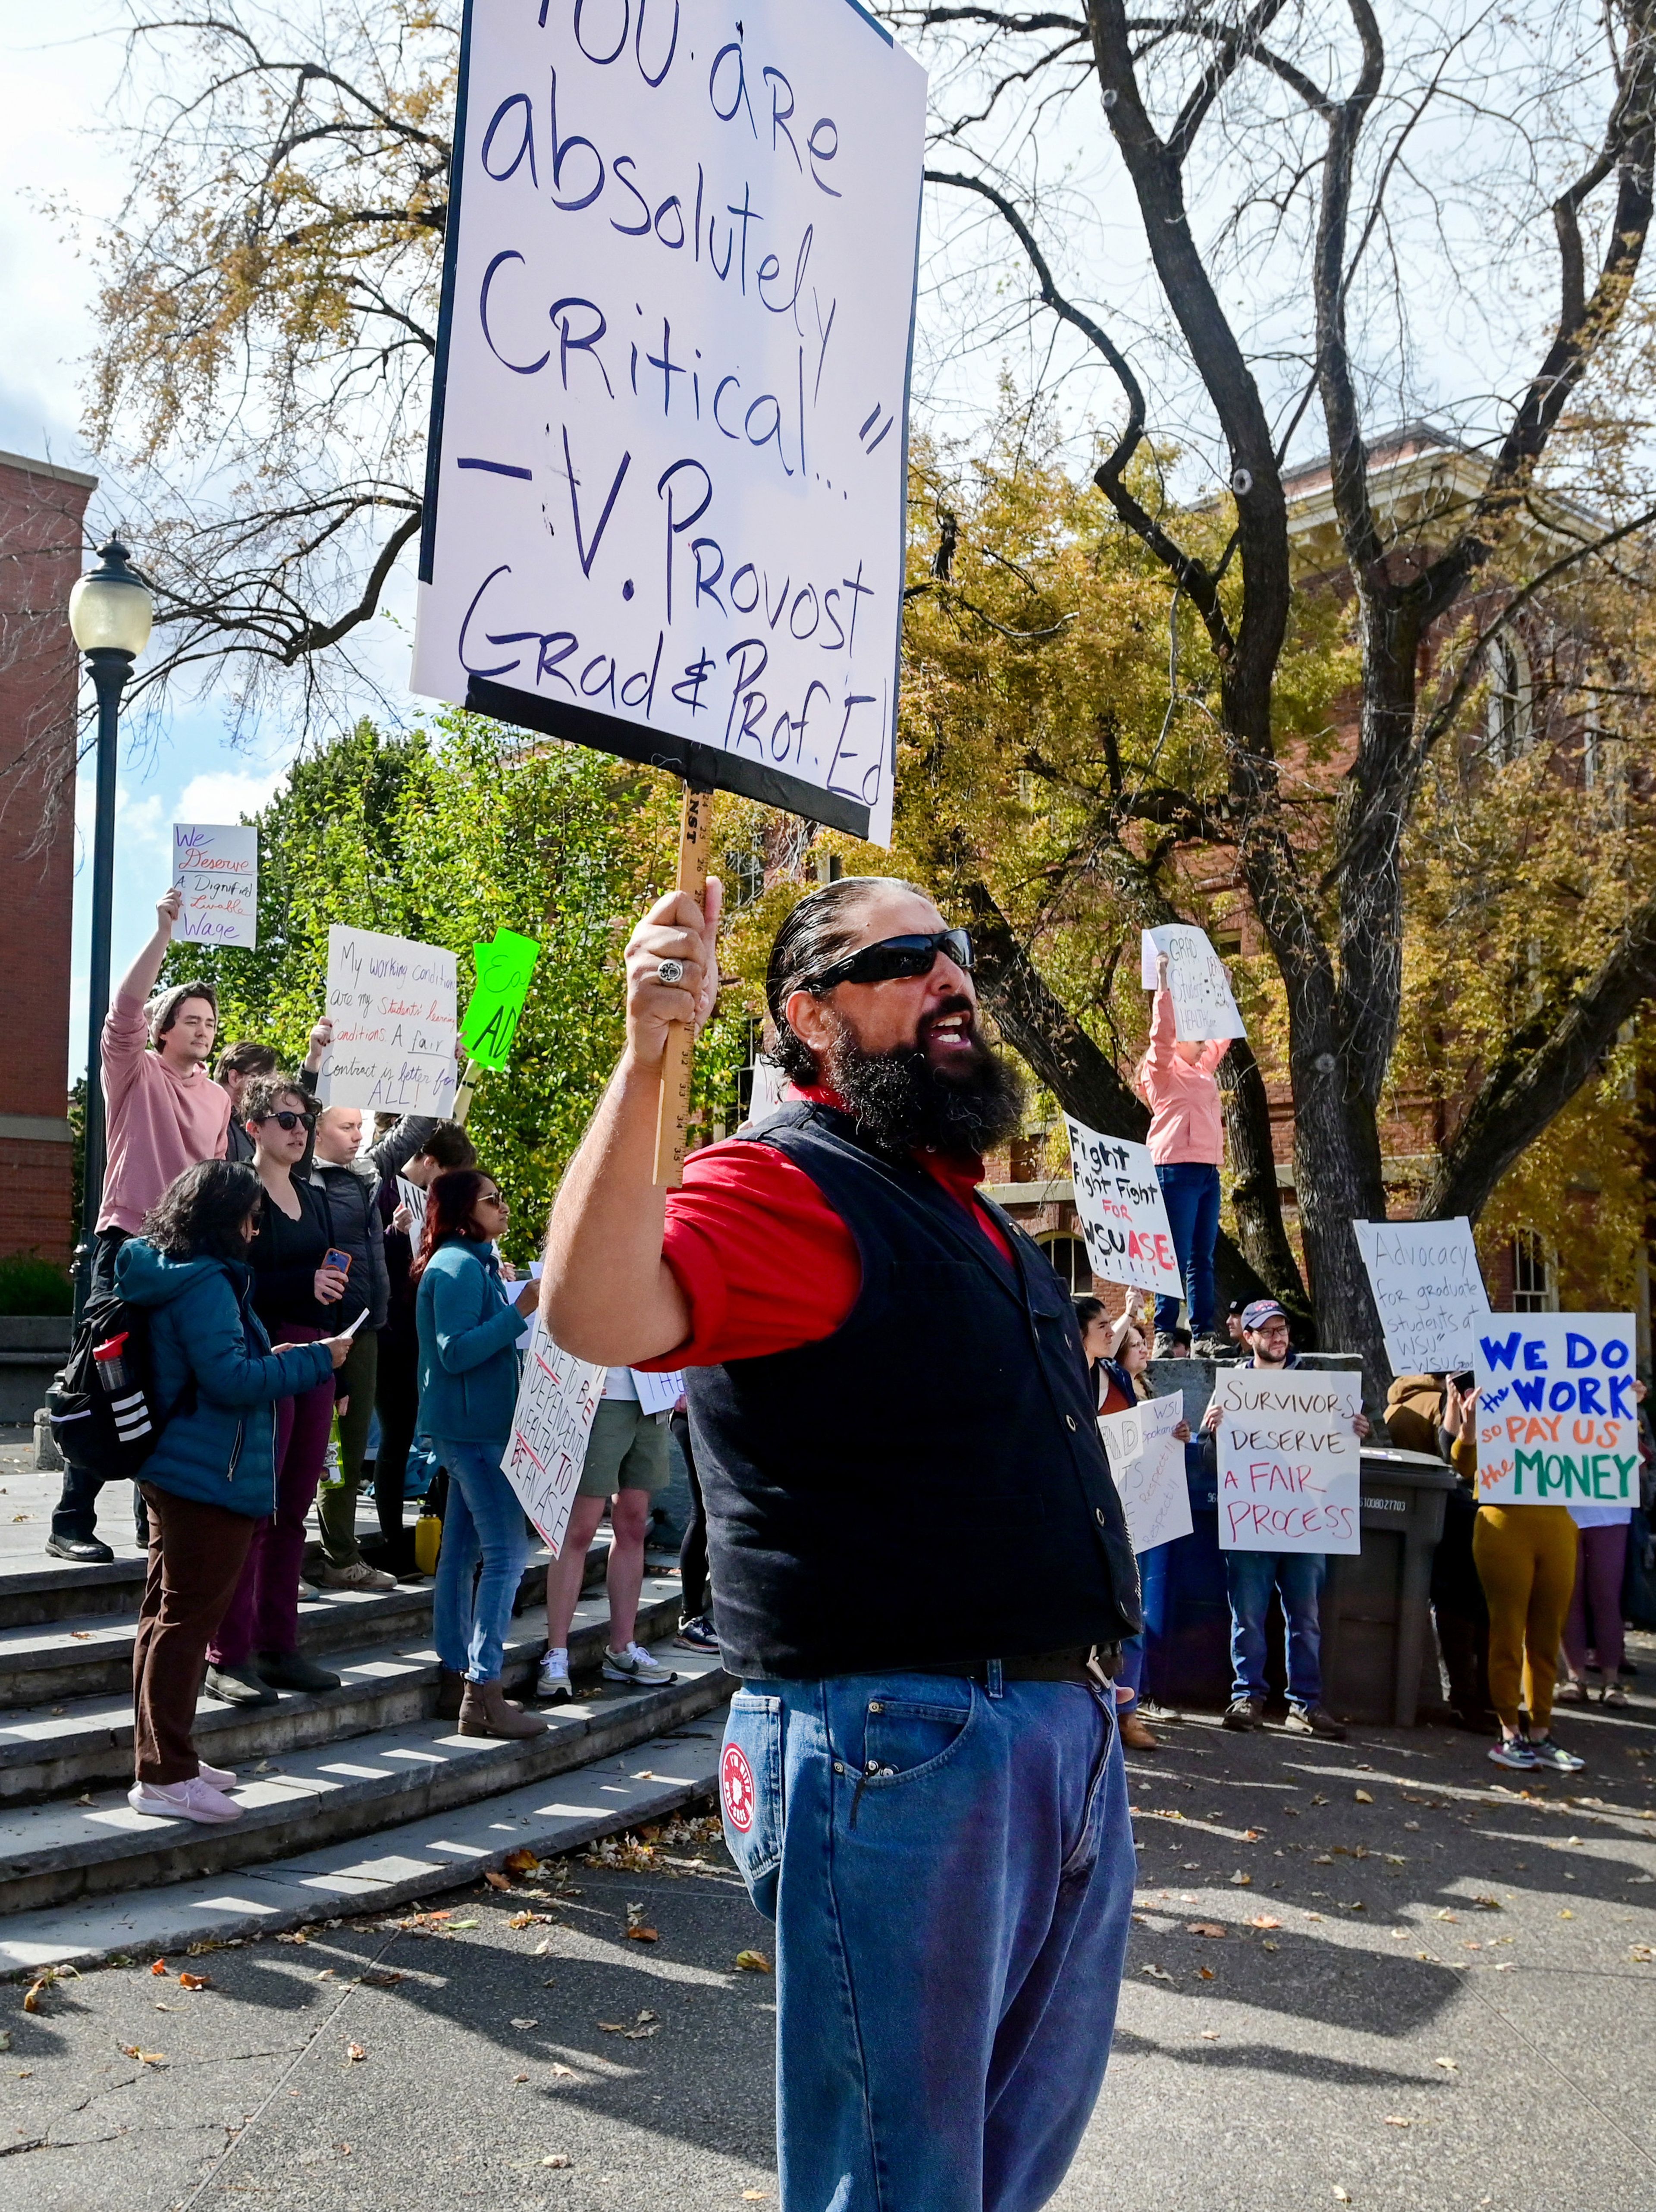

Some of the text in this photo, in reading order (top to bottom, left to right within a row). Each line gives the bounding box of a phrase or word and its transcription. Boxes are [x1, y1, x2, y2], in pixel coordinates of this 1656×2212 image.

[481, 66, 835, 407] absolutely
[672, 647, 716, 716] &
[826, 677, 888, 805] Ed
[176, 826, 215, 846] We
[179, 848, 256, 872] Deserve
[174, 874, 252, 900] A Dignified
[190, 895, 254, 916] Livable
[184, 912, 240, 943] Wage
[340, 941, 362, 989] My
[370, 958, 408, 990] working
[1169, 936, 1198, 961] GRAD
[330, 990, 352, 1007] are
[358, 993, 373, 1018] my
[391, 1024, 402, 1047] A
[322, 1056, 455, 1095] Contract is better for
[1069, 1124, 1129, 1175] Fight
[1073, 1162, 1157, 1205] Fight Fight
[1101, 1199, 1133, 1222] FOR
[1387, 1304, 1479, 1333] students at
[1479, 1332, 1630, 1372] WE DO
[576, 1380, 594, 1425] BE
[1153, 1401, 1181, 1420] WSU
[1223, 1380, 1355, 1419] SURVIVORS
[1479, 1373, 1634, 1420] the WORK
[1231, 1430, 1346, 1454] DESERVE
[1505, 1414, 1563, 1445] PAY
[1572, 1419, 1622, 1448] US
[555, 1452, 572, 1496] TO
[1224, 1462, 1327, 1493] A FAIR
[1480, 1448, 1639, 1500] the MONEY
[511, 1439, 569, 1546] BE AN ASE
[1227, 1500, 1355, 1543] PROCESS
